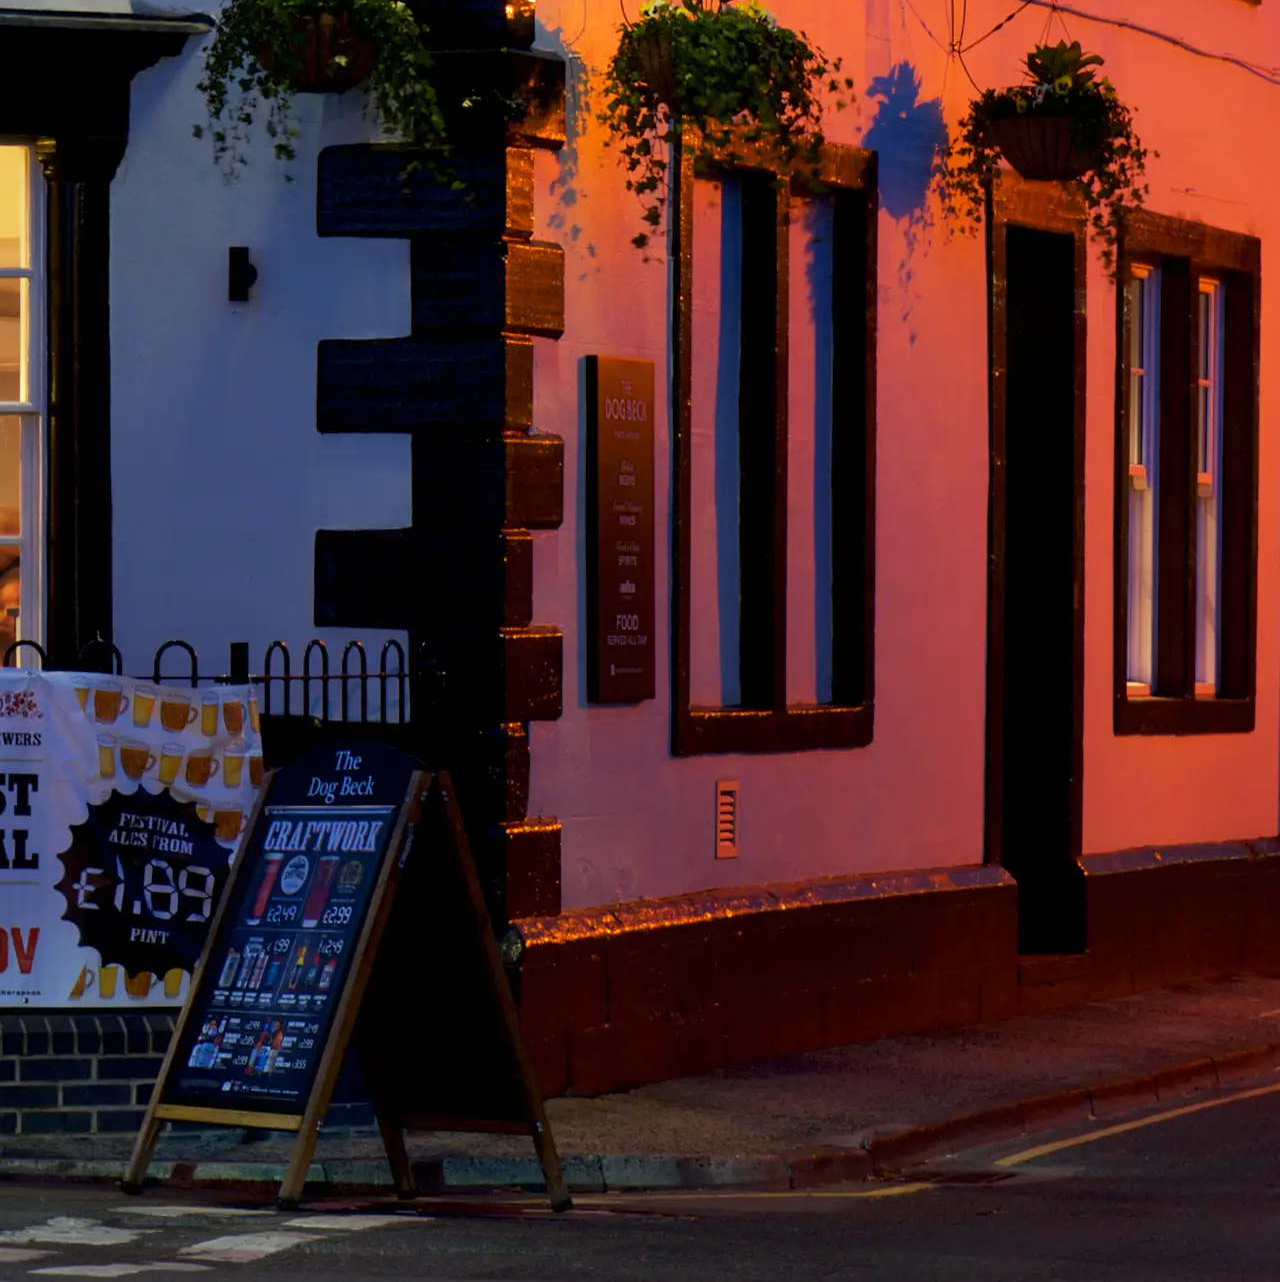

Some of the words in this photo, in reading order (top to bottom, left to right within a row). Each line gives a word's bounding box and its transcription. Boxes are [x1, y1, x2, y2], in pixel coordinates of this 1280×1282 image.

[604, 396, 626, 421] DOG
[626, 399, 647, 422] BECK
[616, 614, 639, 632] FOOD
[334, 749, 363, 772] The
[307, 776, 339, 804] Dog
[339, 775, 375, 797] Beck
[118, 812, 190, 839] FESTIVAL
[263, 820, 384, 853] CRAFTWORK
[108, 829, 149, 848] ALES
[151, 834, 195, 856] FROM
[71, 853, 216, 923] £1.89
[129, 926, 170, 945] PINT
